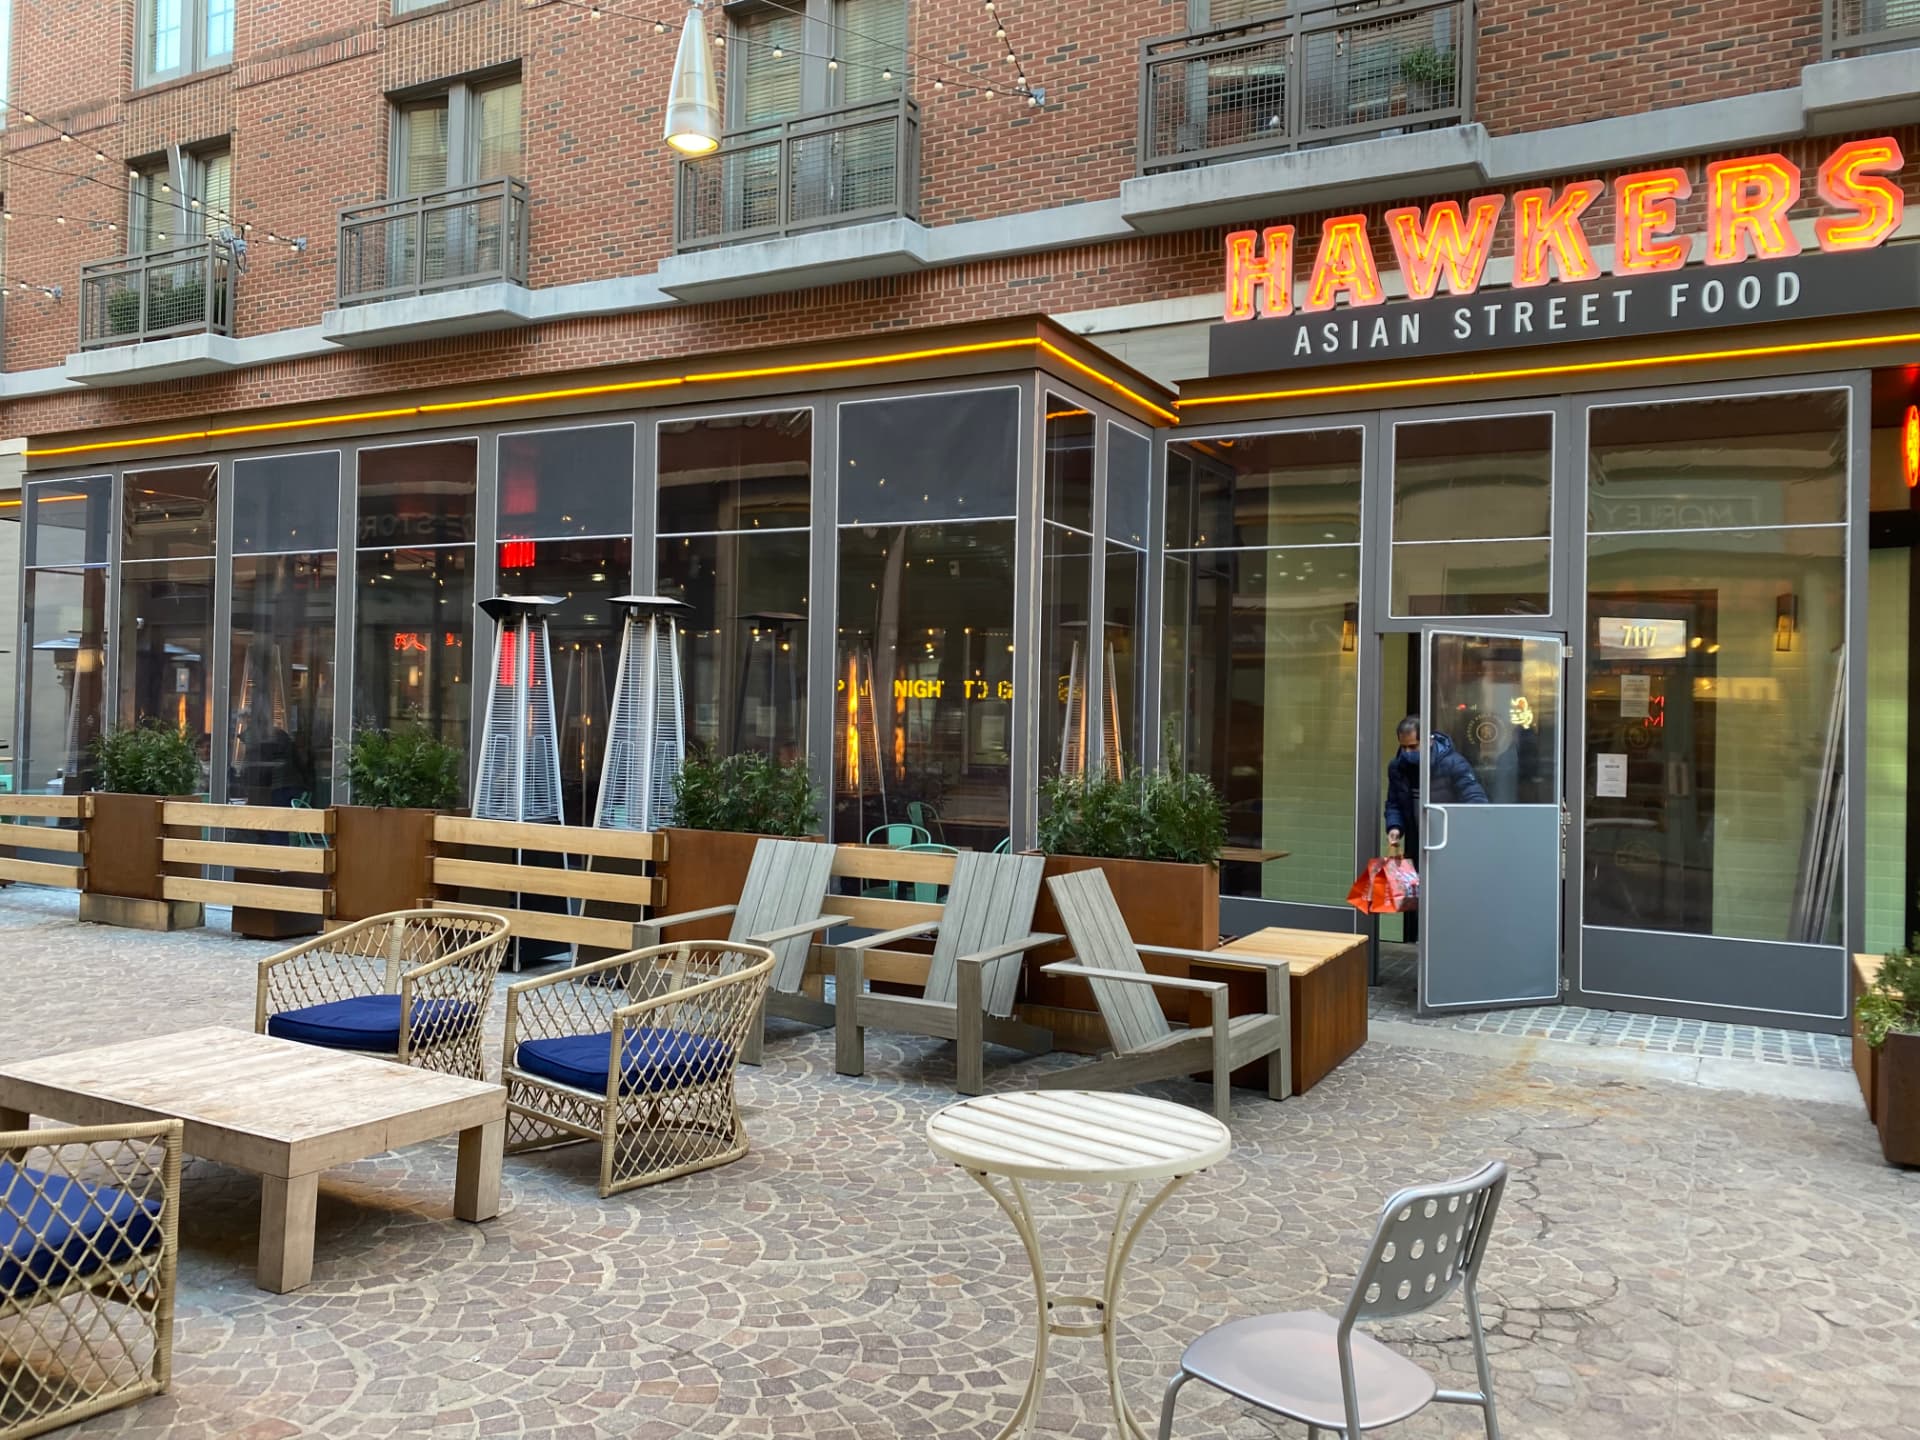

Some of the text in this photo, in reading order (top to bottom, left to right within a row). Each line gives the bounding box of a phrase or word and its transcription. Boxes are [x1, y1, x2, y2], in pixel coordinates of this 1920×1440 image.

[1224, 136, 1904, 322] HAWKERS
[1293, 271, 1801, 356] ASIAN STREET FOOD
[1622, 625, 1658, 648] 7117
[894, 680, 945, 699] NIGH
